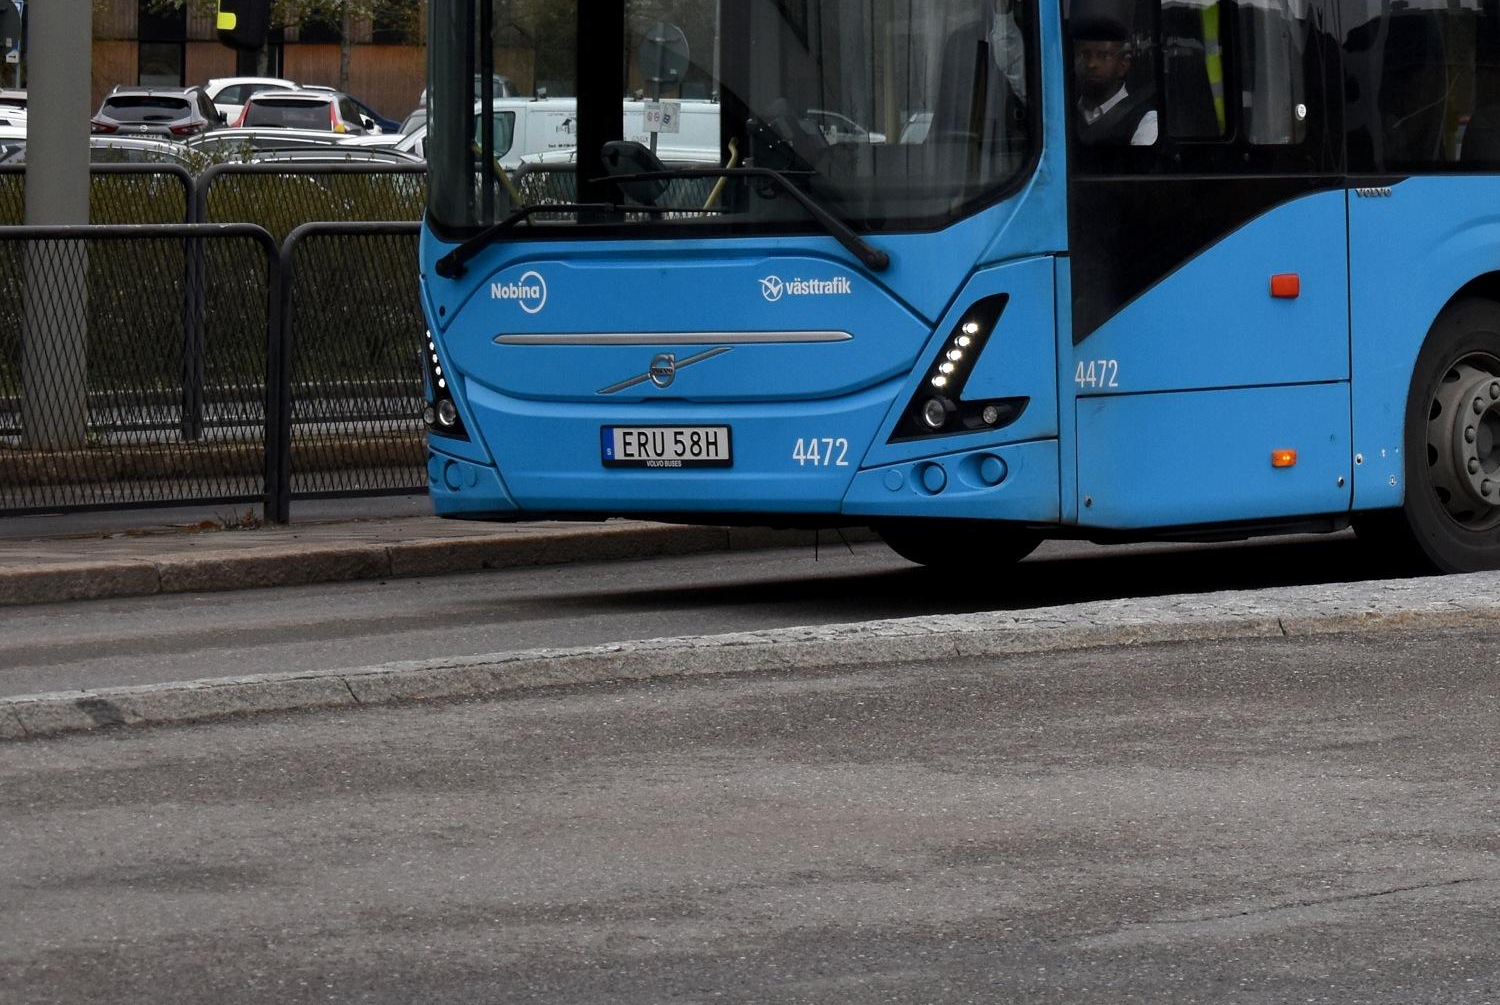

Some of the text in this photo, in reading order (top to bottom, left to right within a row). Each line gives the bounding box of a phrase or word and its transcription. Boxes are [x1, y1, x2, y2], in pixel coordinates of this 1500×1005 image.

[491, 281, 540, 299] Nobina
[786, 277, 851, 296] västtrafik
[1074, 360, 1118, 388] 4472
[622, 431, 718, 458] ERU 58H
[793, 438, 848, 466] 4472
